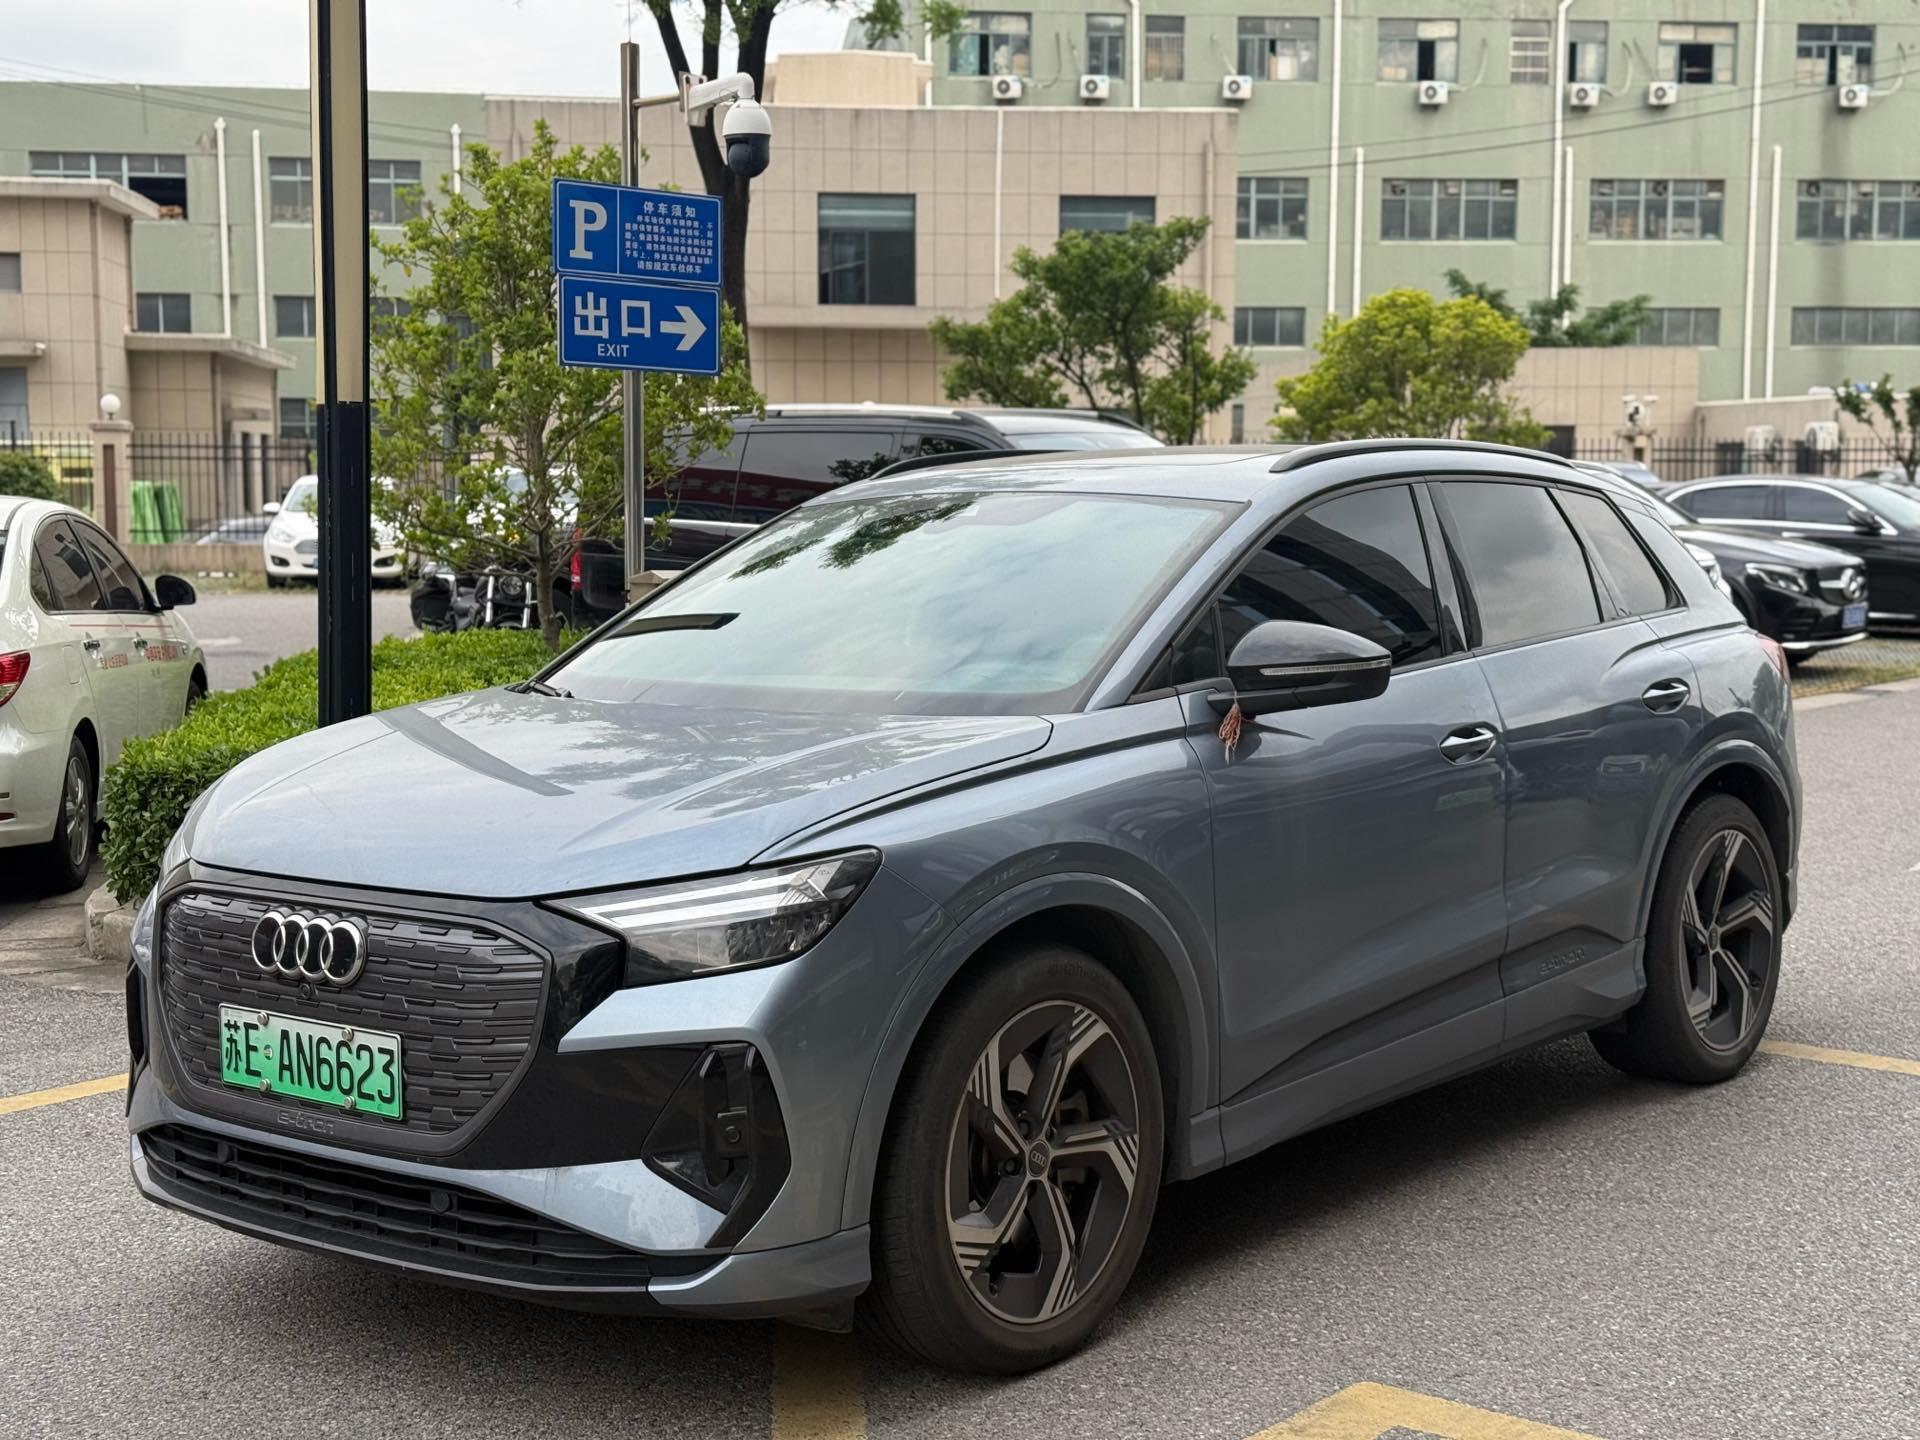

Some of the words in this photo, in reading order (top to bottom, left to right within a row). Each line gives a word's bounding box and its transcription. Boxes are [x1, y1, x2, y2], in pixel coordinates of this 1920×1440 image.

[643, 200, 696, 218] 停车须知
[569, 199, 608, 260] P
[574, 291, 651, 339] 出口
[597, 343, 630, 358] EXIT
